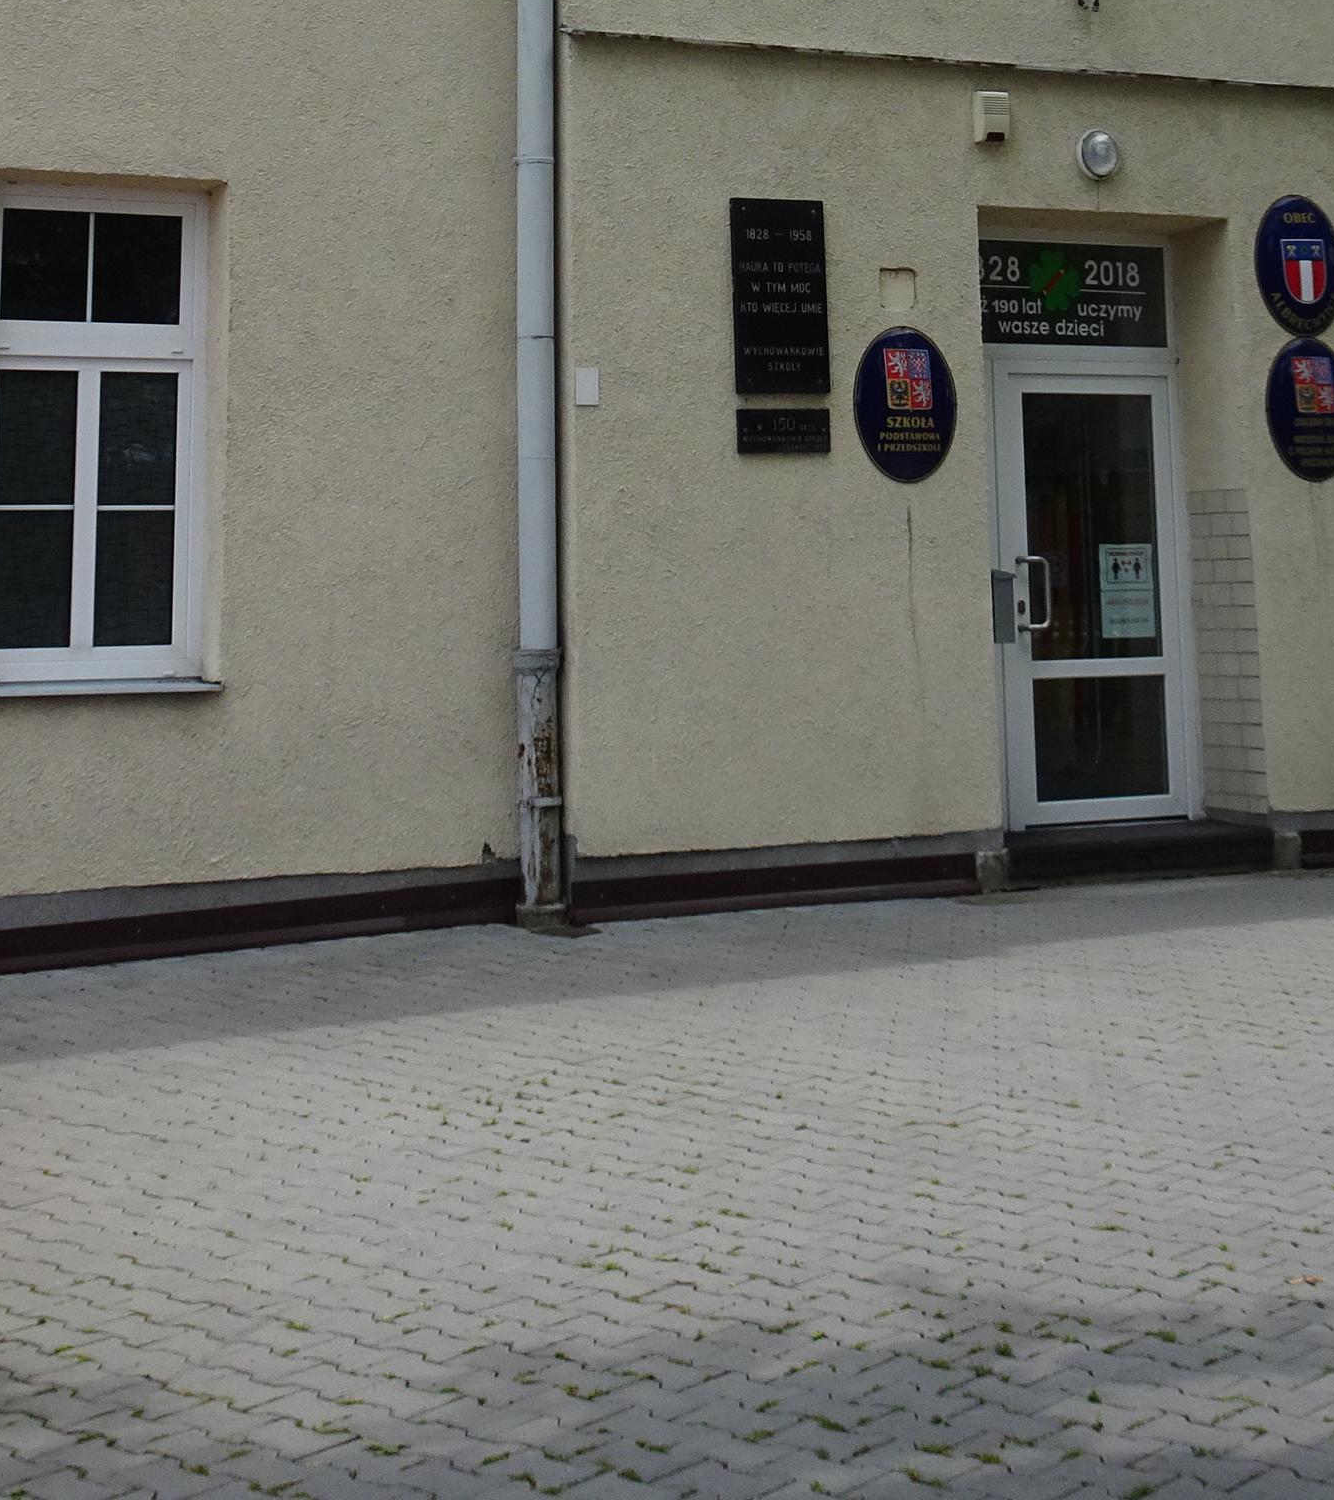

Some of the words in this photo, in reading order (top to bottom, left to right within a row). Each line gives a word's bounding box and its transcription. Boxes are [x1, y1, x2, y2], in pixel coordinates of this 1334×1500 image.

[1283, 212, 1316, 224] OBEC
[746, 228, 770, 240] 1828
[789, 229, 812, 241] 1958
[739, 260, 769, 273] NAUKA
[773, 261, 784, 273] TO
[1084, 260, 1140, 287] 2018
[751, 281, 761, 293] W
[766, 282, 786, 293] TYM
[791, 282, 811, 294] MOC
[740, 302, 758, 313] KTO
[802, 302, 824, 314] UMIE
[992, 299, 1019, 314] 190
[1022, 298, 1042, 314] lat
[1077, 303, 1142, 322] uczymy
[998, 320, 1050, 335] wasze
[1055, 319, 1105, 336] dzieci
[772, 418, 796, 431] 150
[886, 416, 935, 428] SZKOŁA
[879, 431, 941, 441] PODSTAWOWA
